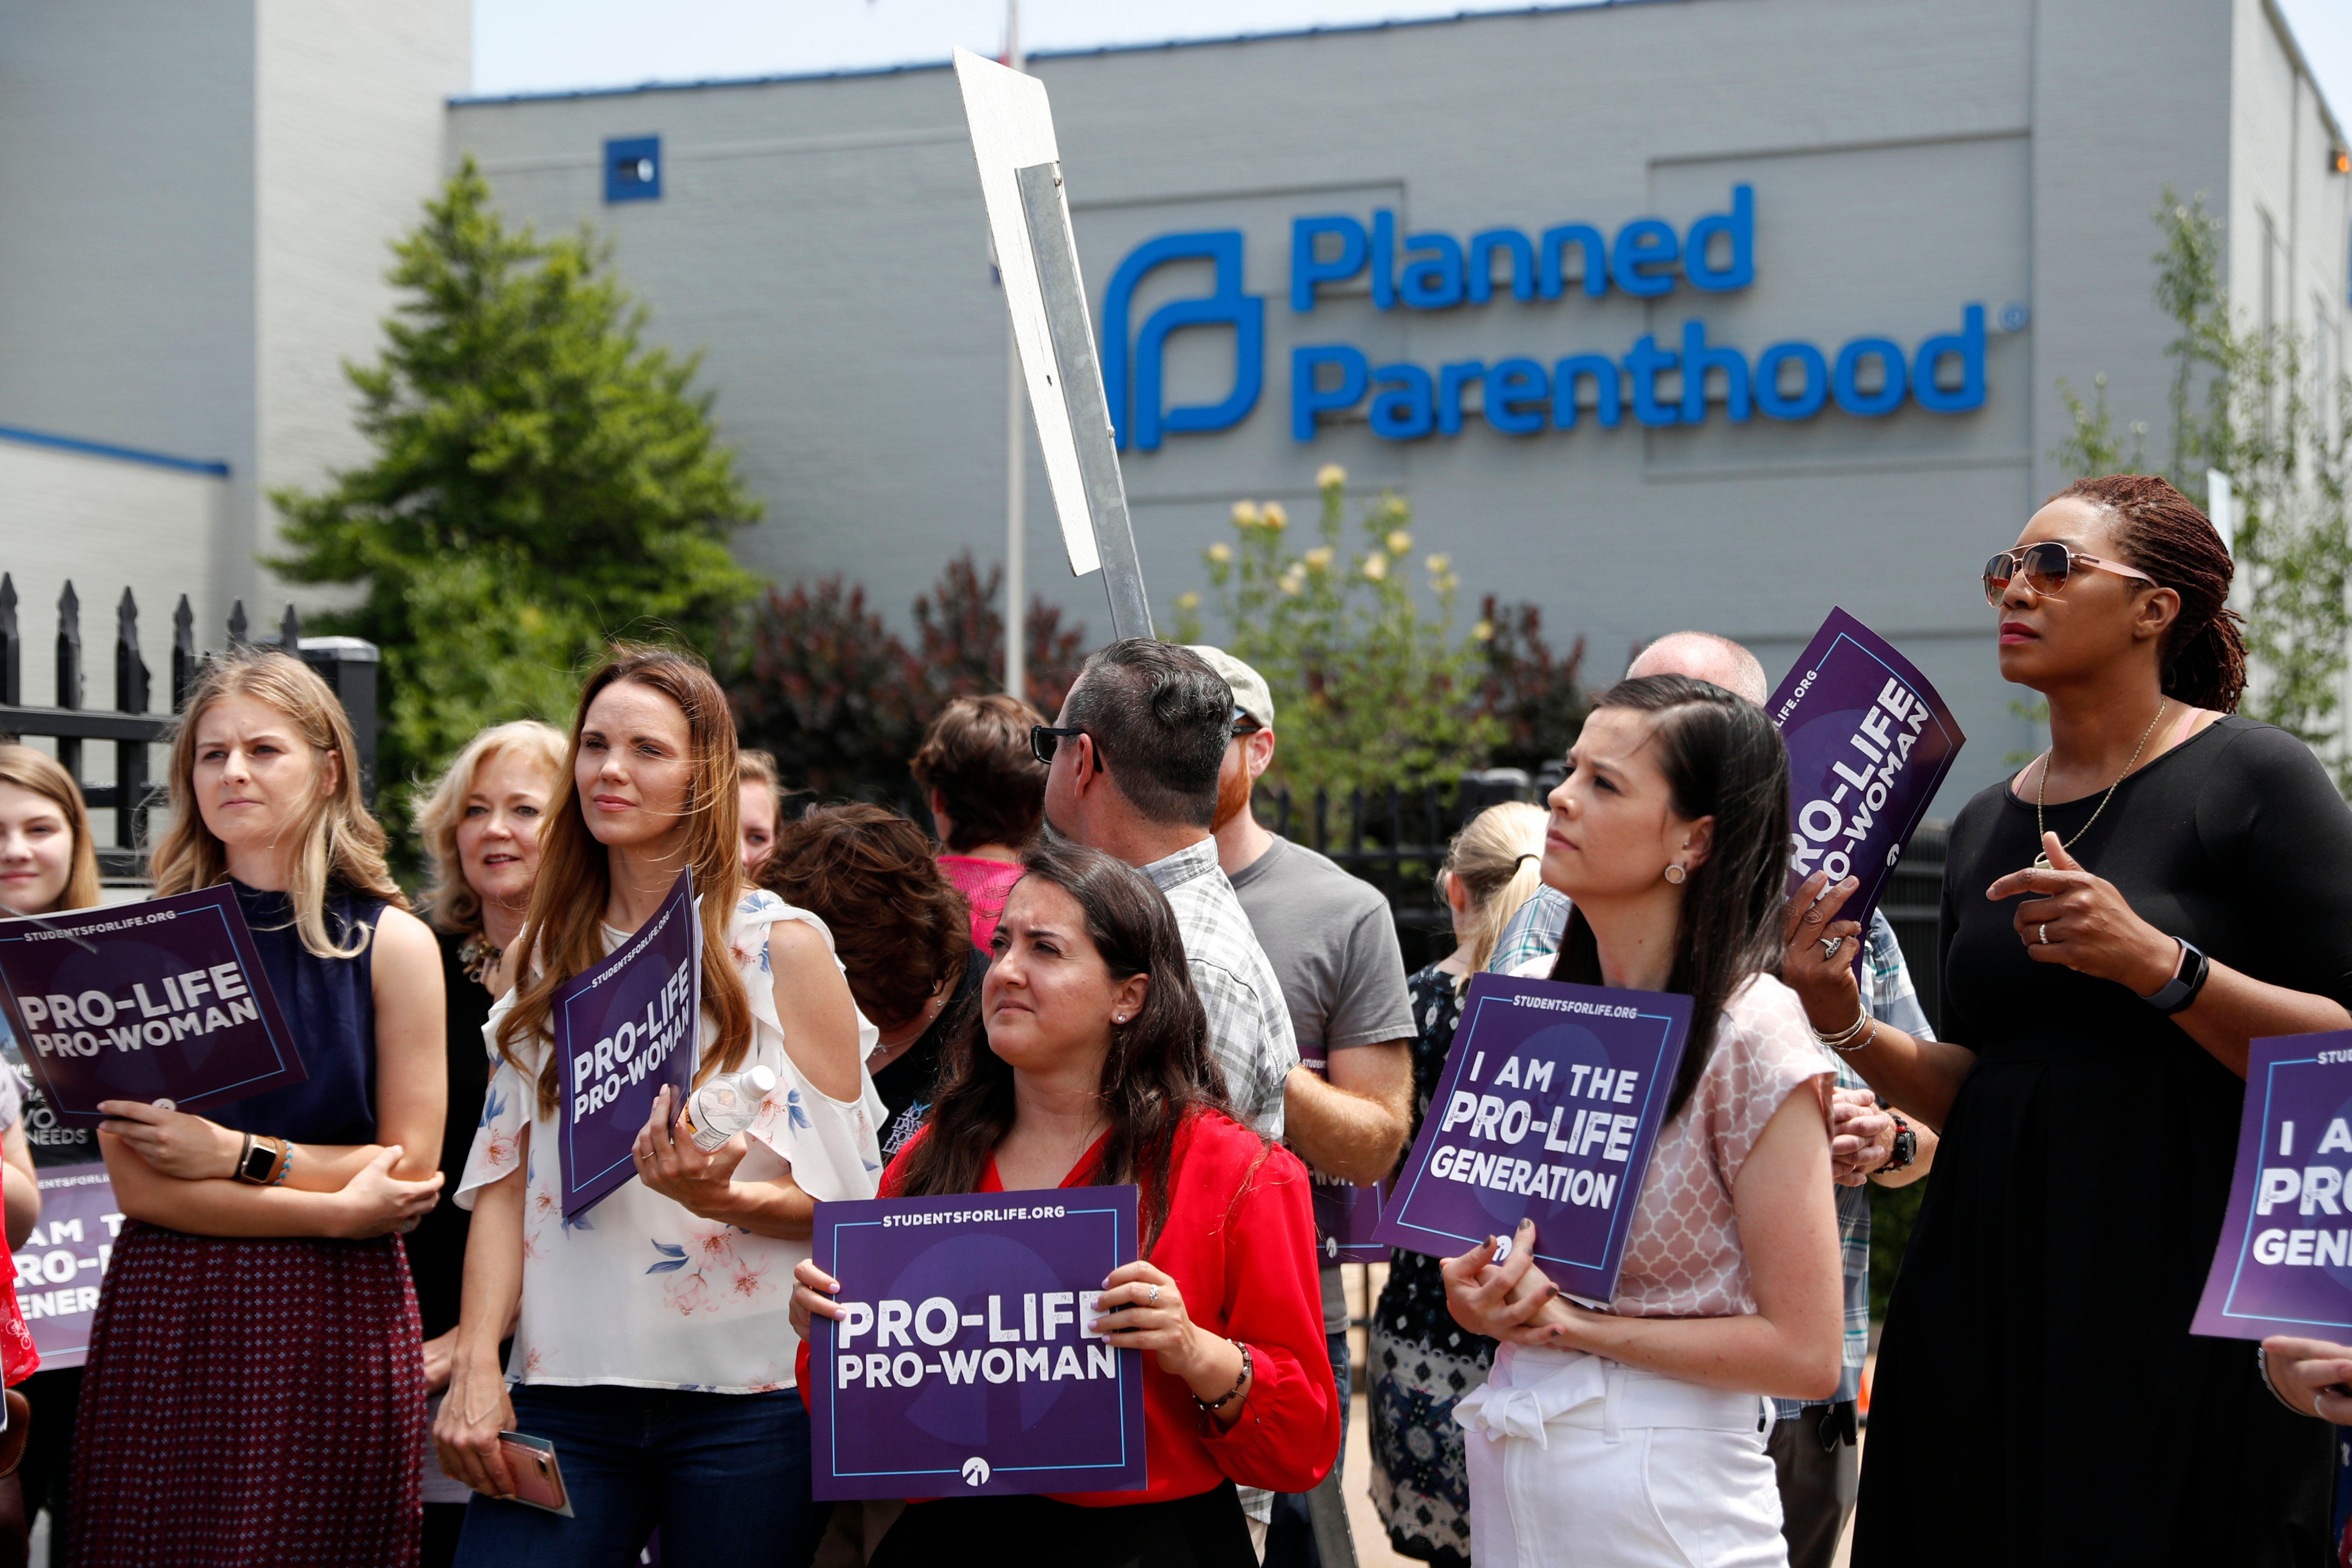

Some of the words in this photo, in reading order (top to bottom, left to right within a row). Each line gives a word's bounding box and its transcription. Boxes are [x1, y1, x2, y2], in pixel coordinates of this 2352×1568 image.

[1291, 184, 1755, 313] Planned
[1291, 303, 1986, 443] Parenthood
[1773, 670, 1817, 731] LIFE.ORG
[1783, 677, 1914, 895] RO-LIFE
[24, 910, 176, 941] STUDENTSFORLIFE.ORG
[592, 911, 670, 987] STUDENTSFORLIFE.ORG
[18, 961, 248, 1030] PRO-LIFE
[574, 957, 689, 1093] PRO-LIFE
[1513, 995, 1637, 1019] STUDENTSFORLIFE.ORG
[32, 997, 259, 1058] PRO-WOMAN
[574, 998, 689, 1124] PRO-WOMAN
[1302, 1059, 1326, 1069] STUDENT
[1469, 1051, 1484, 1082] I
[1494, 1056, 1555, 1093] AM
[1569, 1065, 1639, 1103] THE
[891, 1117, 925, 1132] DAYS
[1441, 1090, 1637, 1162] PRO-LIFE
[2280, 1121, 2294, 1156] I
[1430, 1145, 1617, 1210] GENERATION
[2256, 1166, 2352, 1215] PR
[882, 1206, 1065, 1227] STUDENTSFORLIFE.ORG
[2253, 1229, 2352, 1266] GEN
[838, 1345, 1115, 1389] PRO-WOMAN
